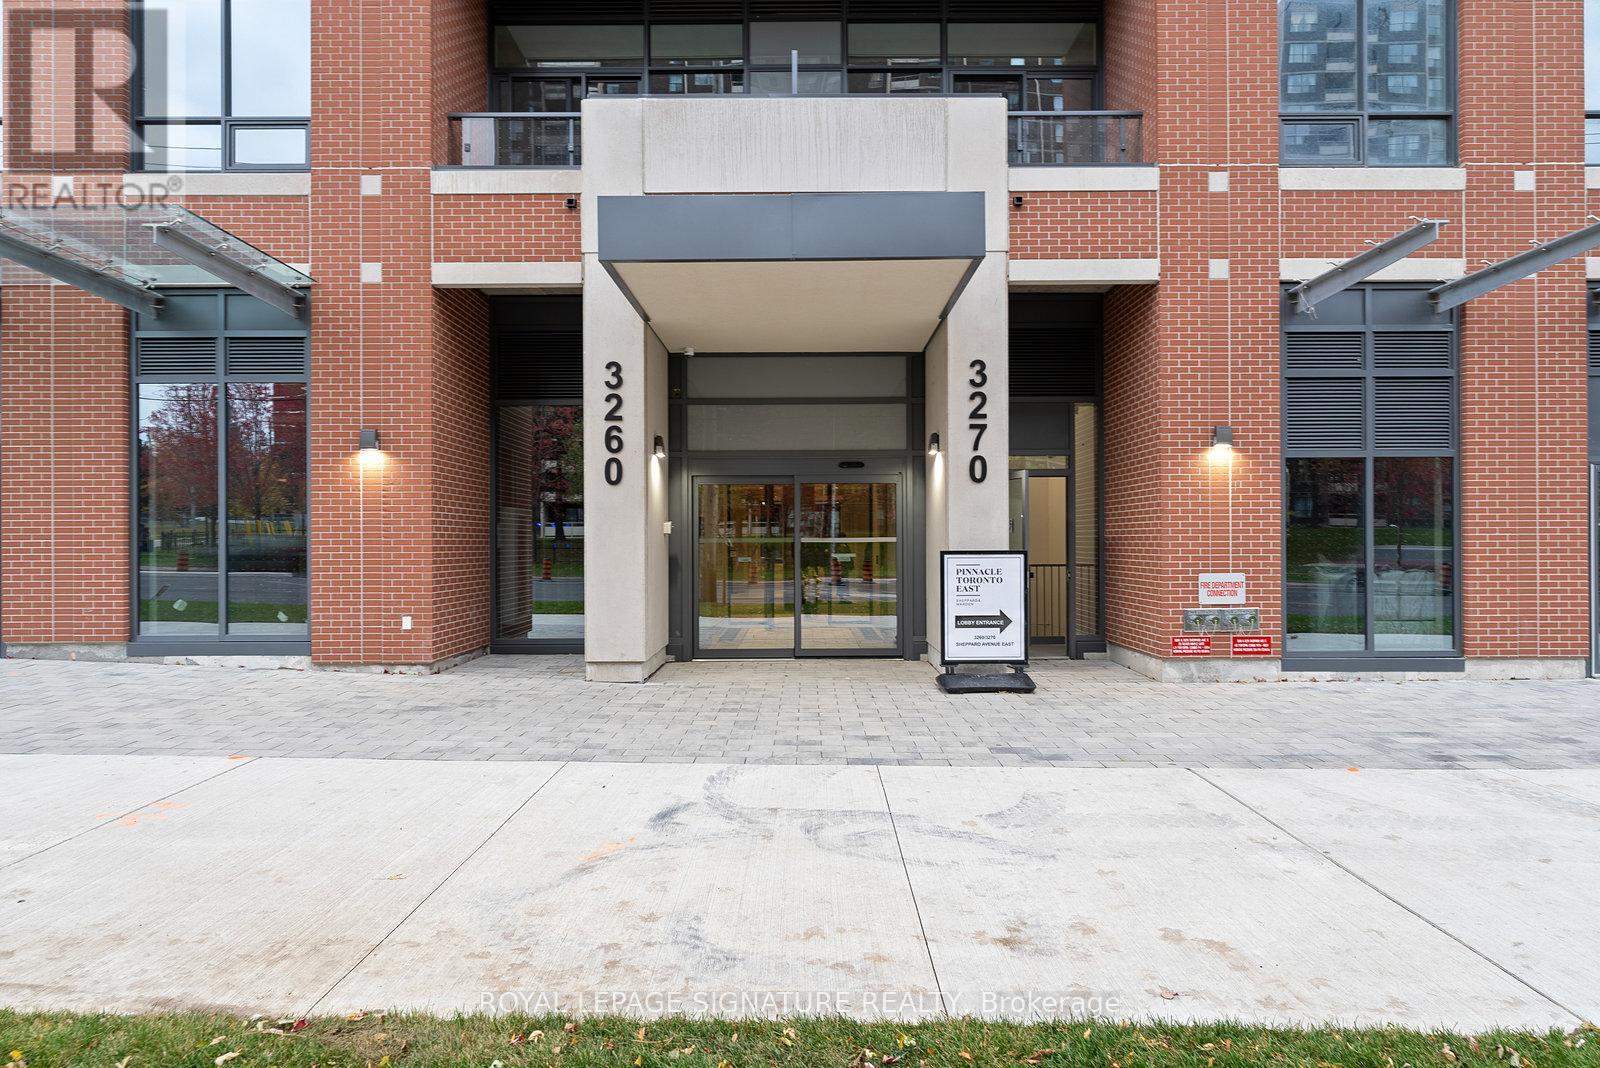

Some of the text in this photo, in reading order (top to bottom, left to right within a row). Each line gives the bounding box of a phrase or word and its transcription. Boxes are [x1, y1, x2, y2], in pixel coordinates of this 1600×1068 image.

[603, 361, 624, 487] 3260
[968, 359, 988, 484] 3270
[956, 568, 1003, 576] PINNACLE
[956, 576, 1003, 584] TORONTO
[956, 585, 981, 593] EAST
[1200, 581, 1244, 589] FIRE DEPARTMENT
[1207, 589, 1238, 597] CONNECTION
